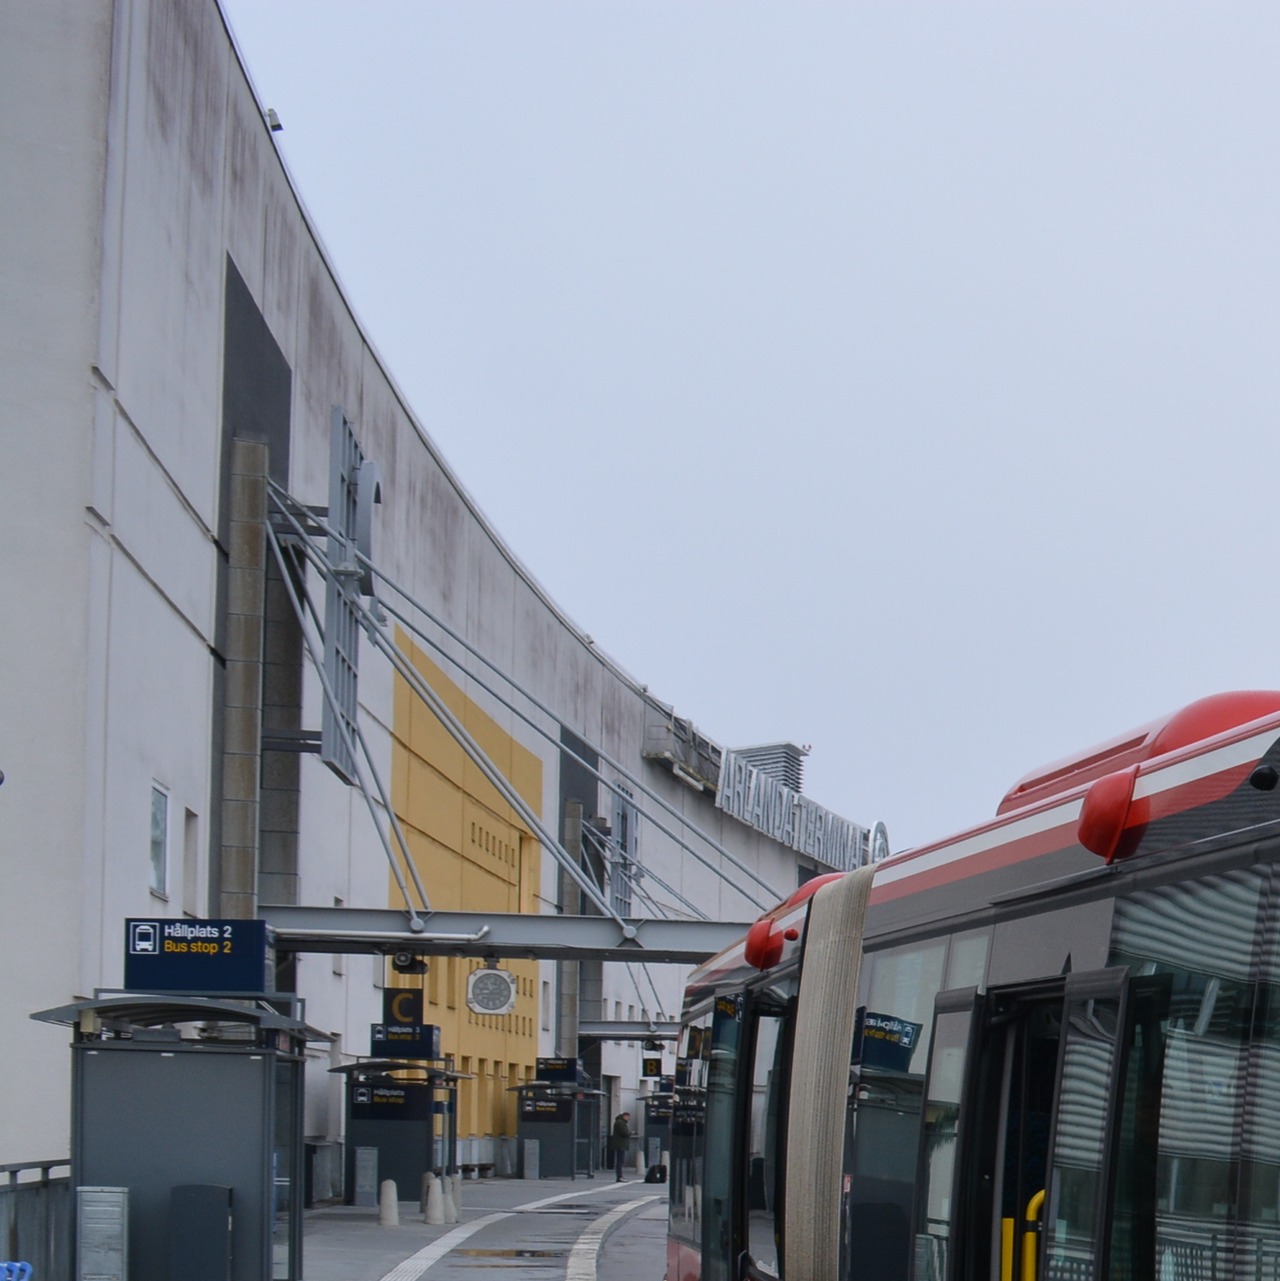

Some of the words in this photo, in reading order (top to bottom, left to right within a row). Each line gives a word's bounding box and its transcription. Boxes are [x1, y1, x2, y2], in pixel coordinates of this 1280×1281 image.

[714, 747, 794, 847] ARLANDA
[164, 922, 220, 940] Hållplats
[223, 925, 232, 938] 2
[164, 940, 188, 952] Bus
[190, 940, 218, 955] stop
[223, 941, 231, 953] 2
[391, 992, 413, 1023] C
[646, 1060, 657, 1075] B
